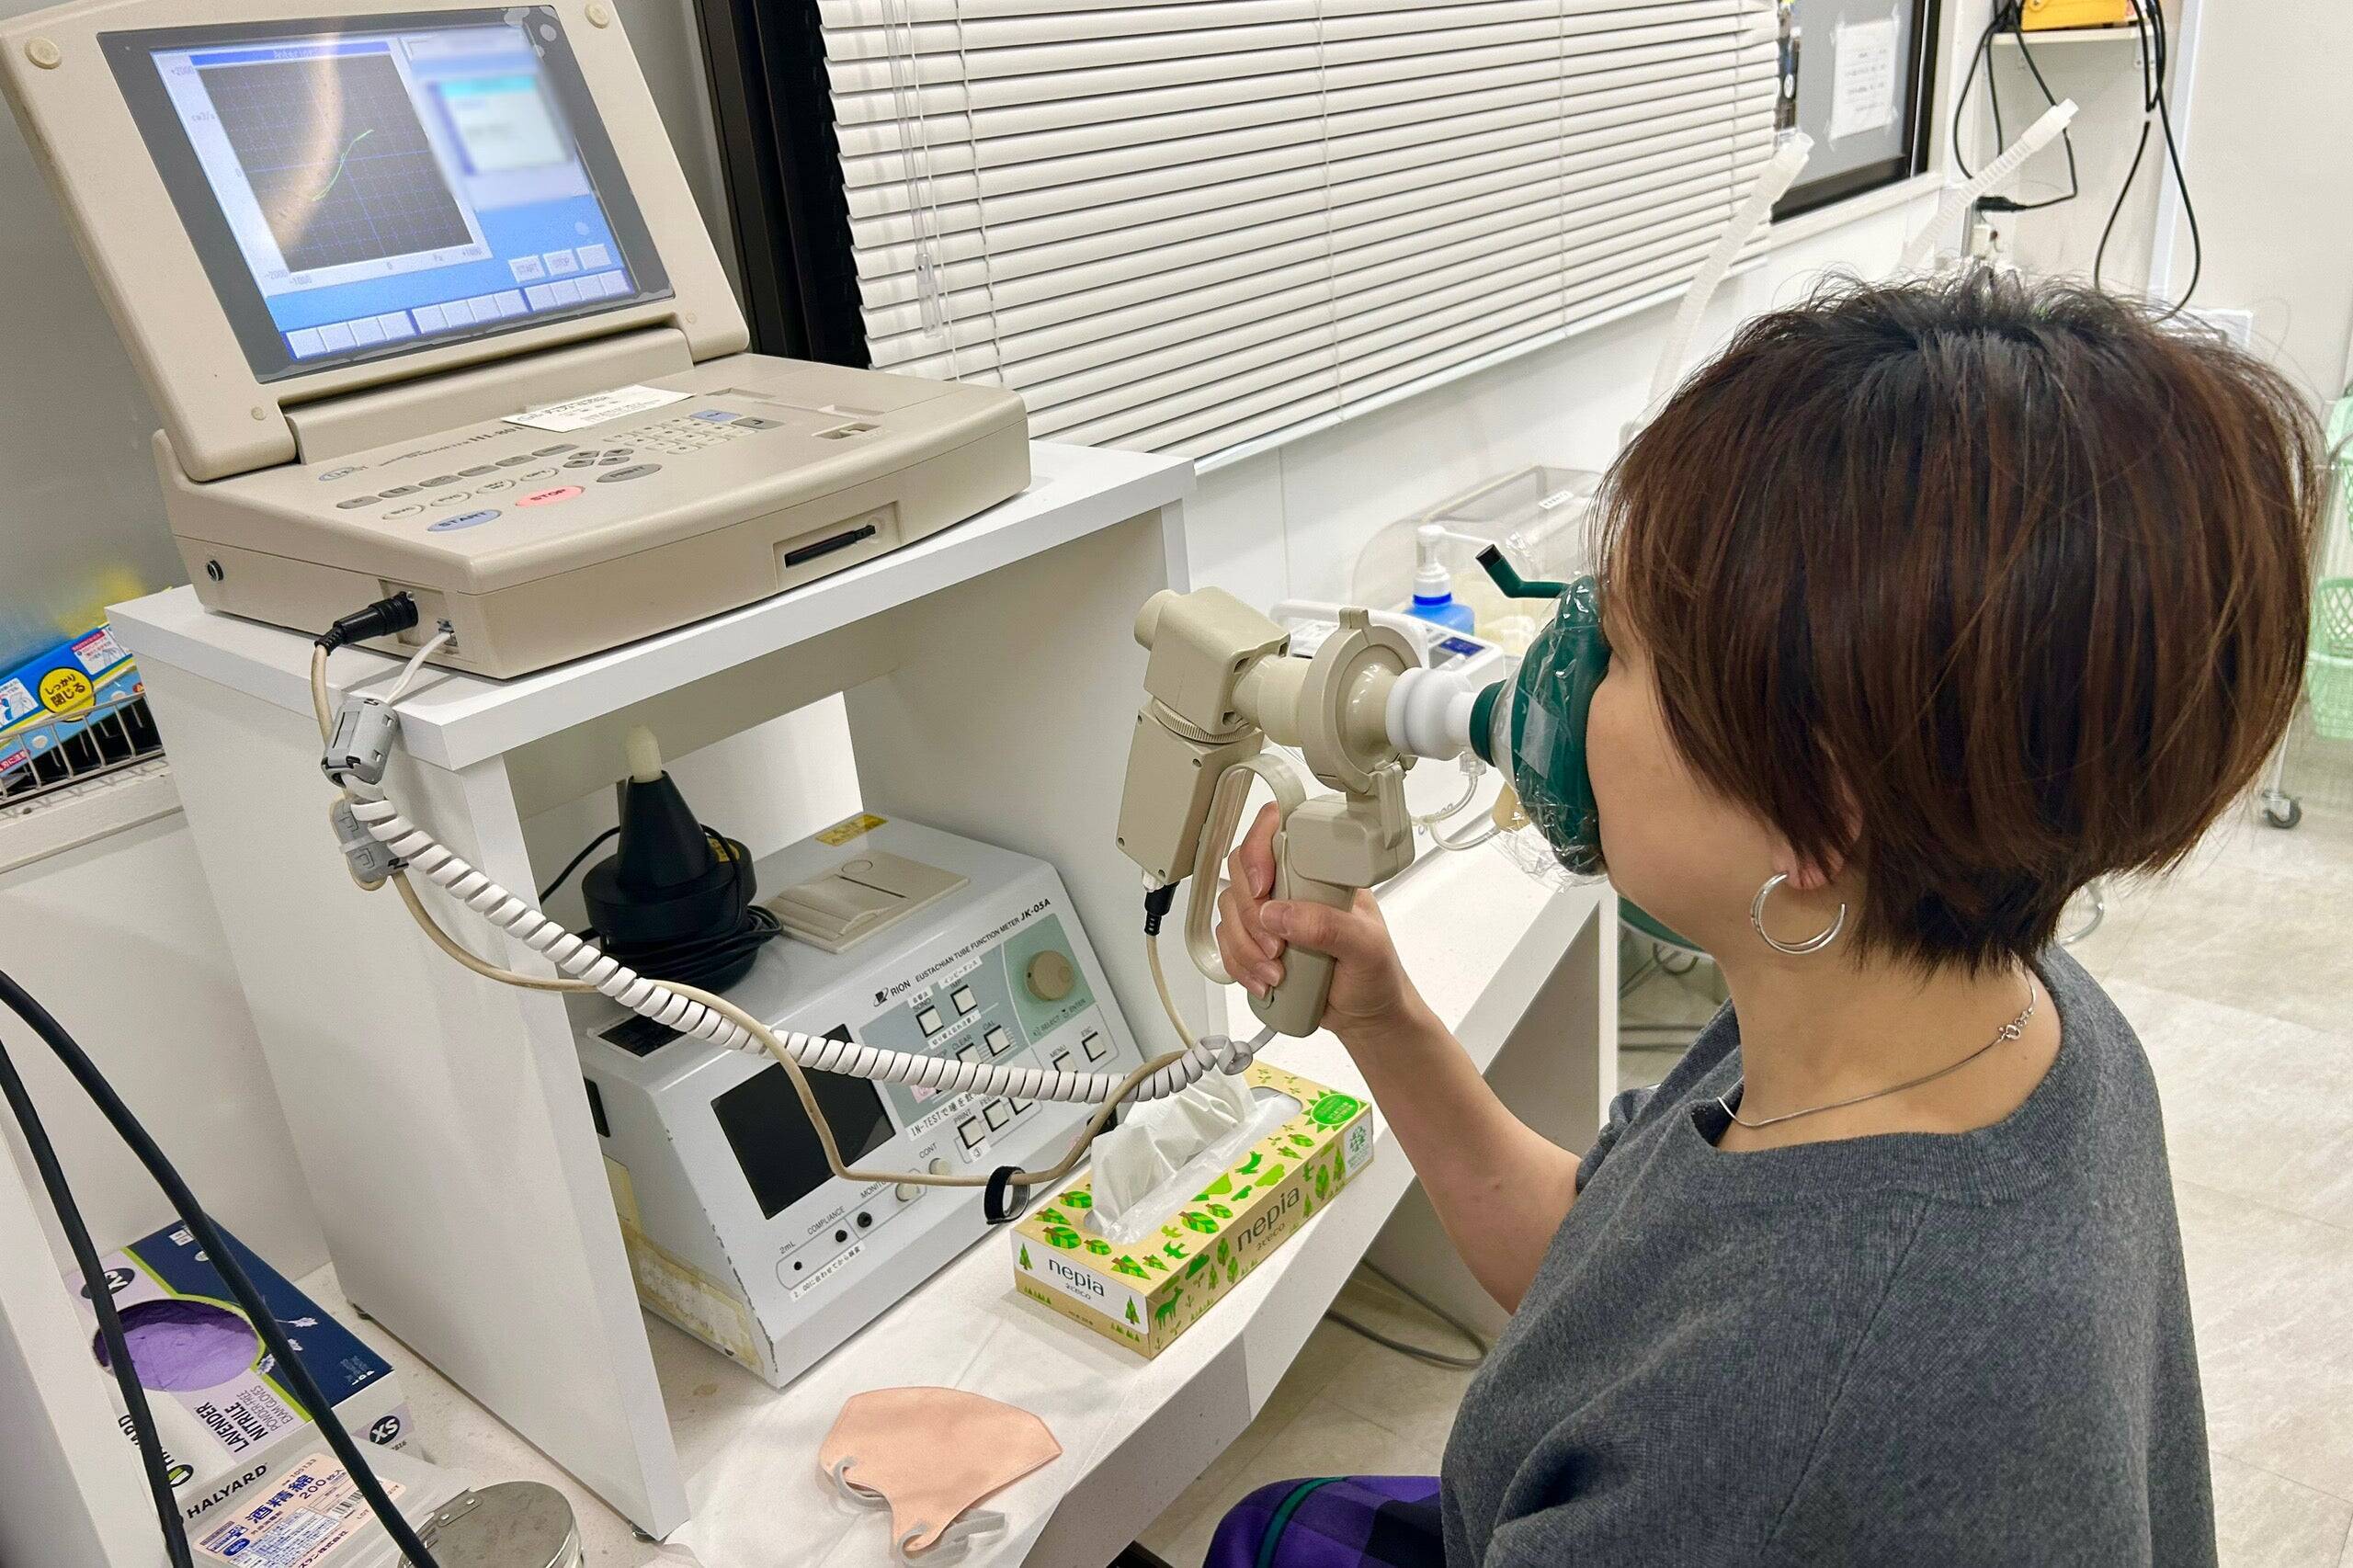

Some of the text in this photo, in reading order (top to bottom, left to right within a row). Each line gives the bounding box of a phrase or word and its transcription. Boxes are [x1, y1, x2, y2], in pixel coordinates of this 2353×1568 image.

[438, 488, 566, 527] START STOP
[44, 673, 76, 696] しっかり
[50, 681, 86, 708] 閉じる
[890, 898, 1051, 997] RION EUSTACHIAN TUBE FUNCTION METER JK-05A
[951, 1034, 973, 1051] CLEAR
[1050, 1044, 1067, 1058] MENU
[919, 1142, 938, 1158] CONT
[807, 1205, 846, 1235] COMPLIANCE
[1237, 1187, 1300, 1252] nepia
[779, 1241, 796, 1255] 2mL
[1049, 1258, 1105, 1297] nepia
[224, 1402, 268, 1441] NITRILE
[236, 1390, 281, 1431] POWDER-FREE
[250, 1384, 293, 1425] EXAM GLOVES
[195, 1402, 250, 1453] LAVENDER
[371, 1417, 398, 1443] XS
[187, 1463, 267, 1518] HALYARD
[245, 1473, 314, 1524] 酒精綿
